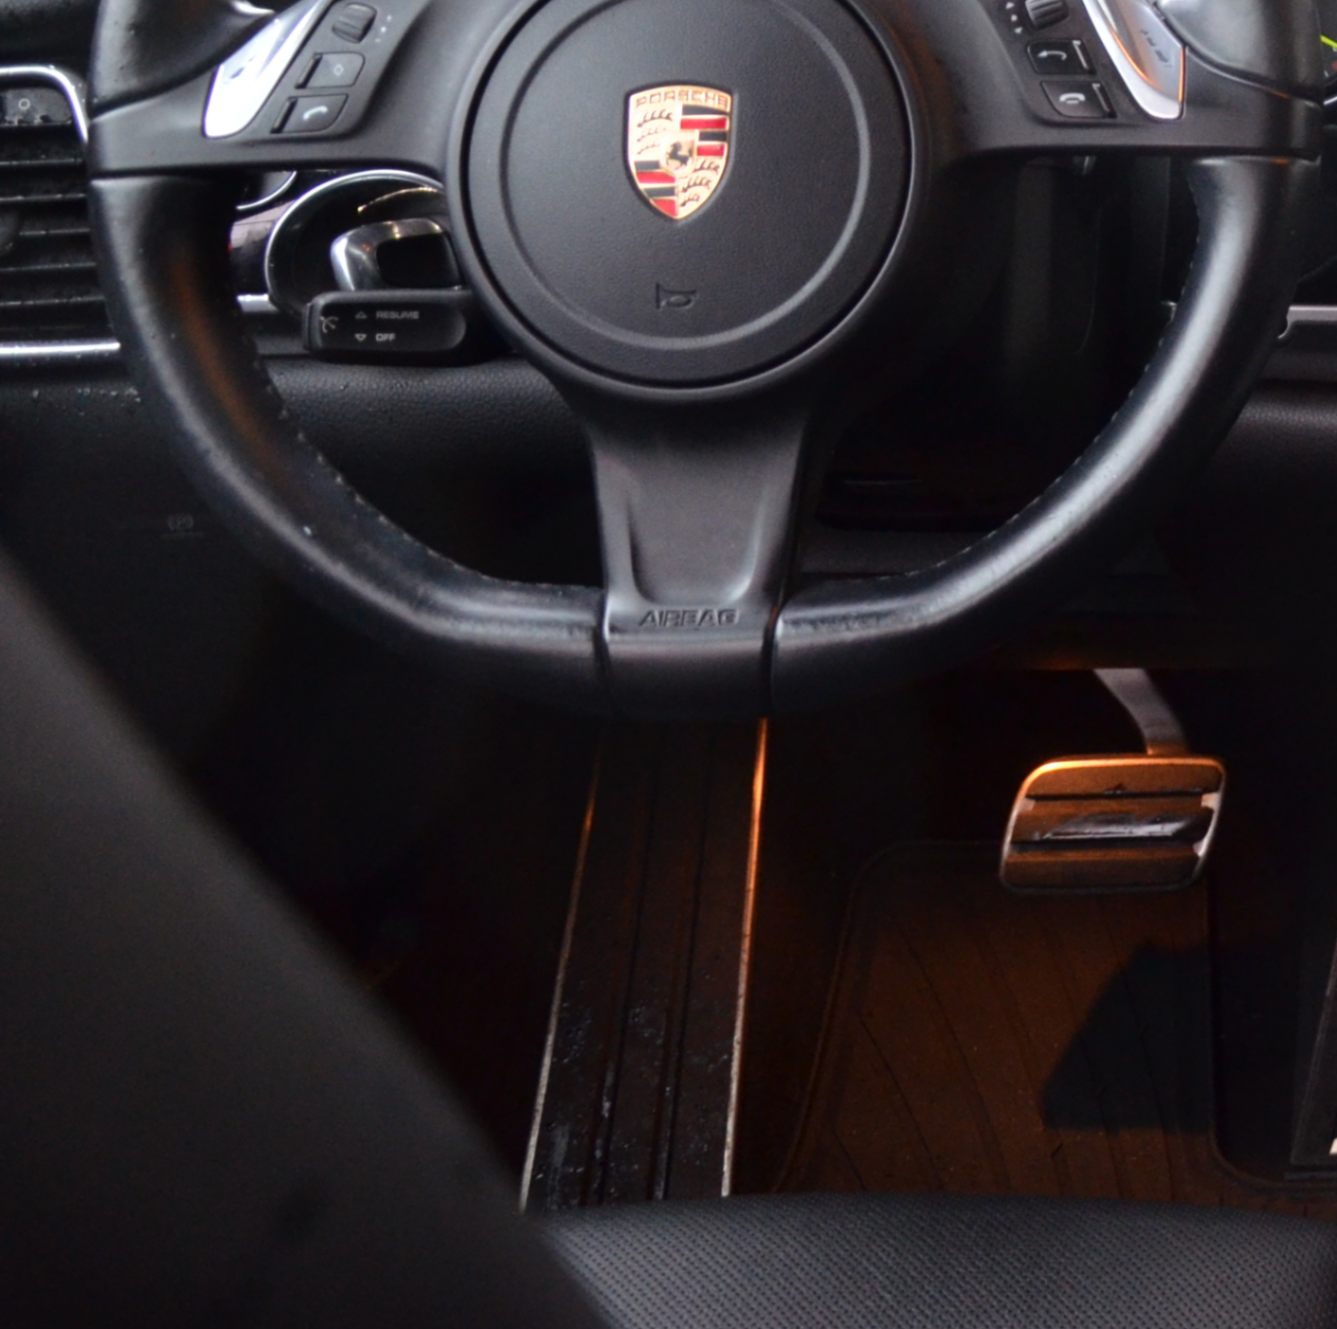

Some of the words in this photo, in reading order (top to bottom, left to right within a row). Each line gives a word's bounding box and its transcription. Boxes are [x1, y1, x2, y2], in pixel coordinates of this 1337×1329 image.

[635, 89, 730, 108] PORSCHE
[375, 310, 420, 320] RESUME
[375, 333, 396, 342] OFF
[638, 608, 739, 627] AIRBAG
